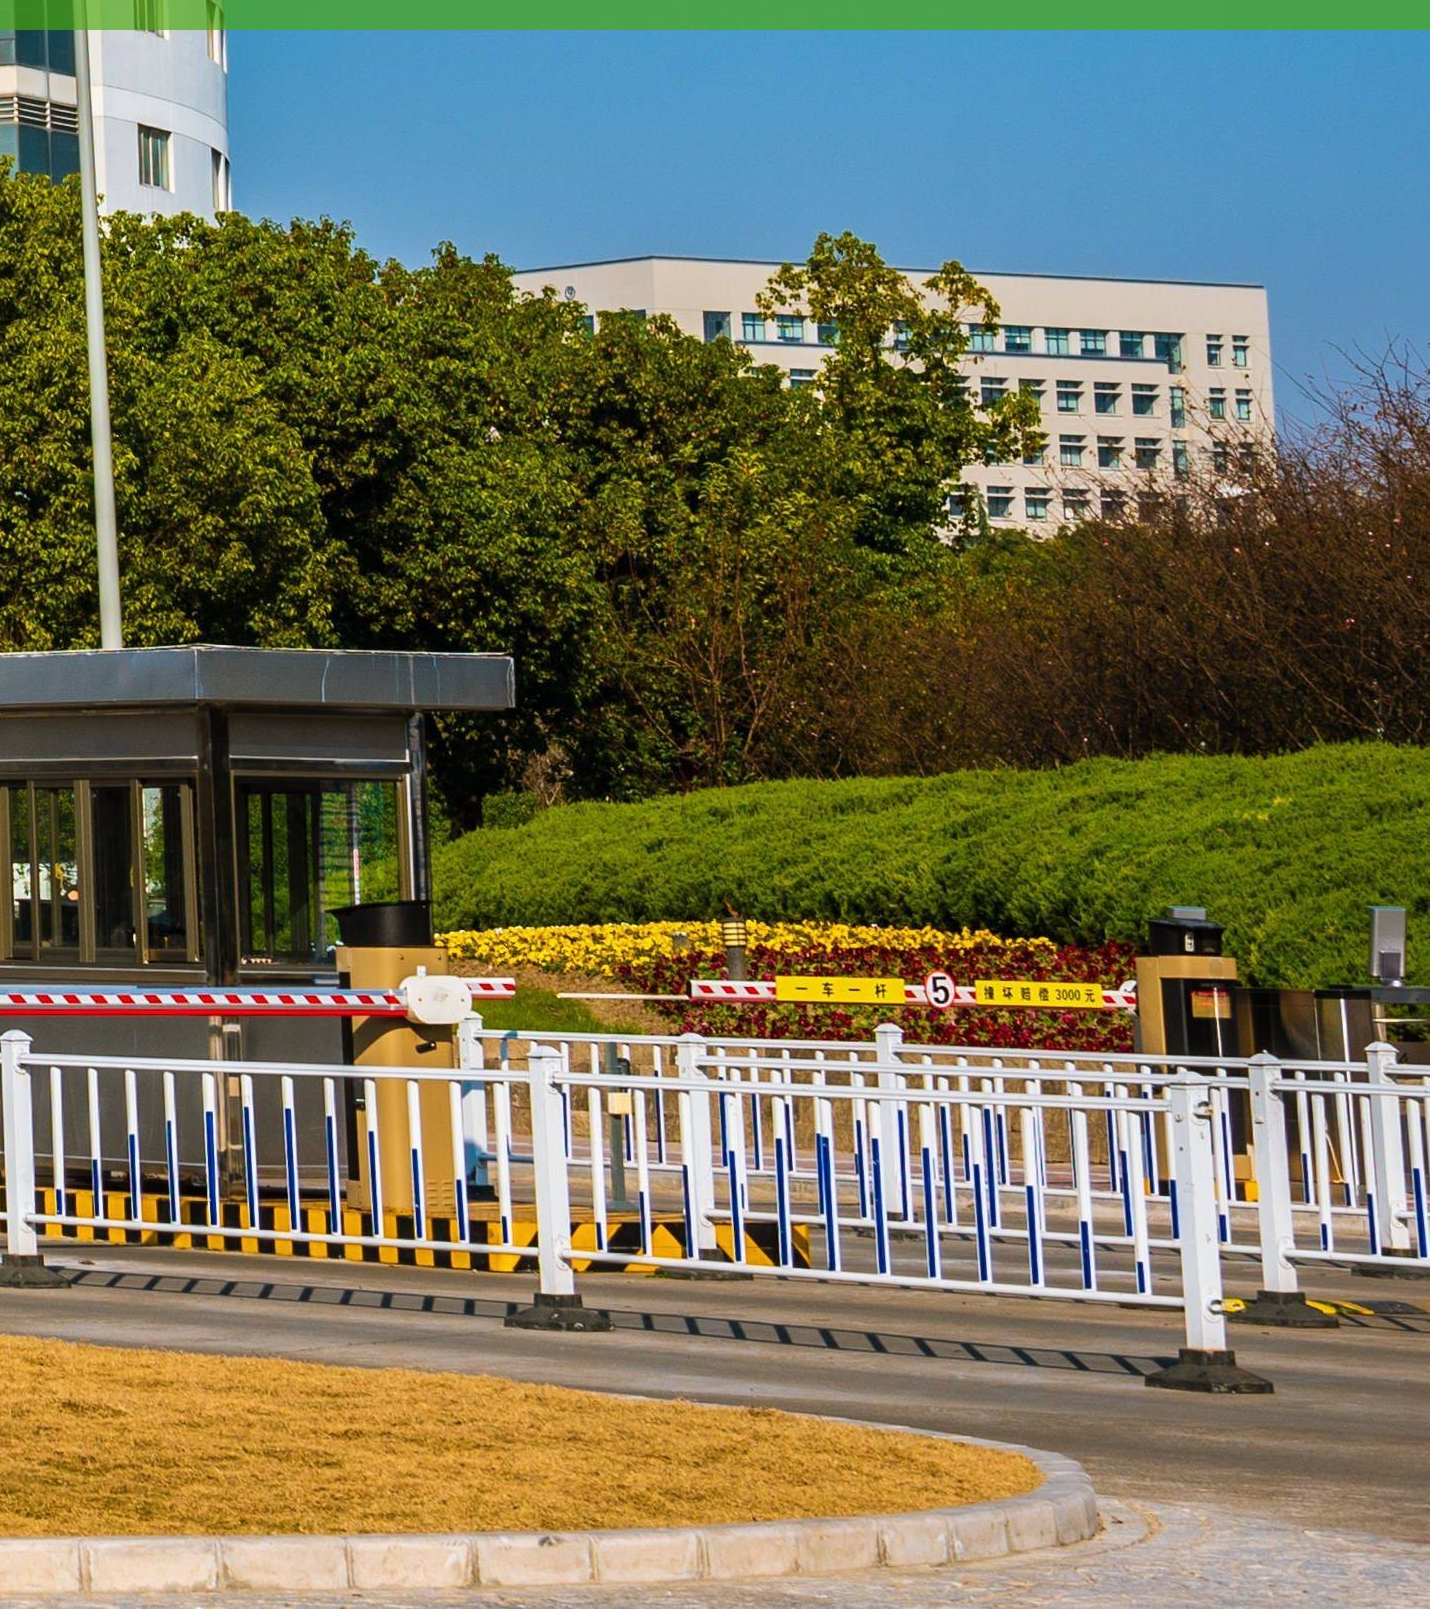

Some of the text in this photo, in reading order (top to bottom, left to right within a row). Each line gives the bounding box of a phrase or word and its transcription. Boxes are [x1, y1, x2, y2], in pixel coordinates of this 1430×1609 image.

[795, 982, 887, 999] 一车一杆
[931, 976, 950, 1005] 5
